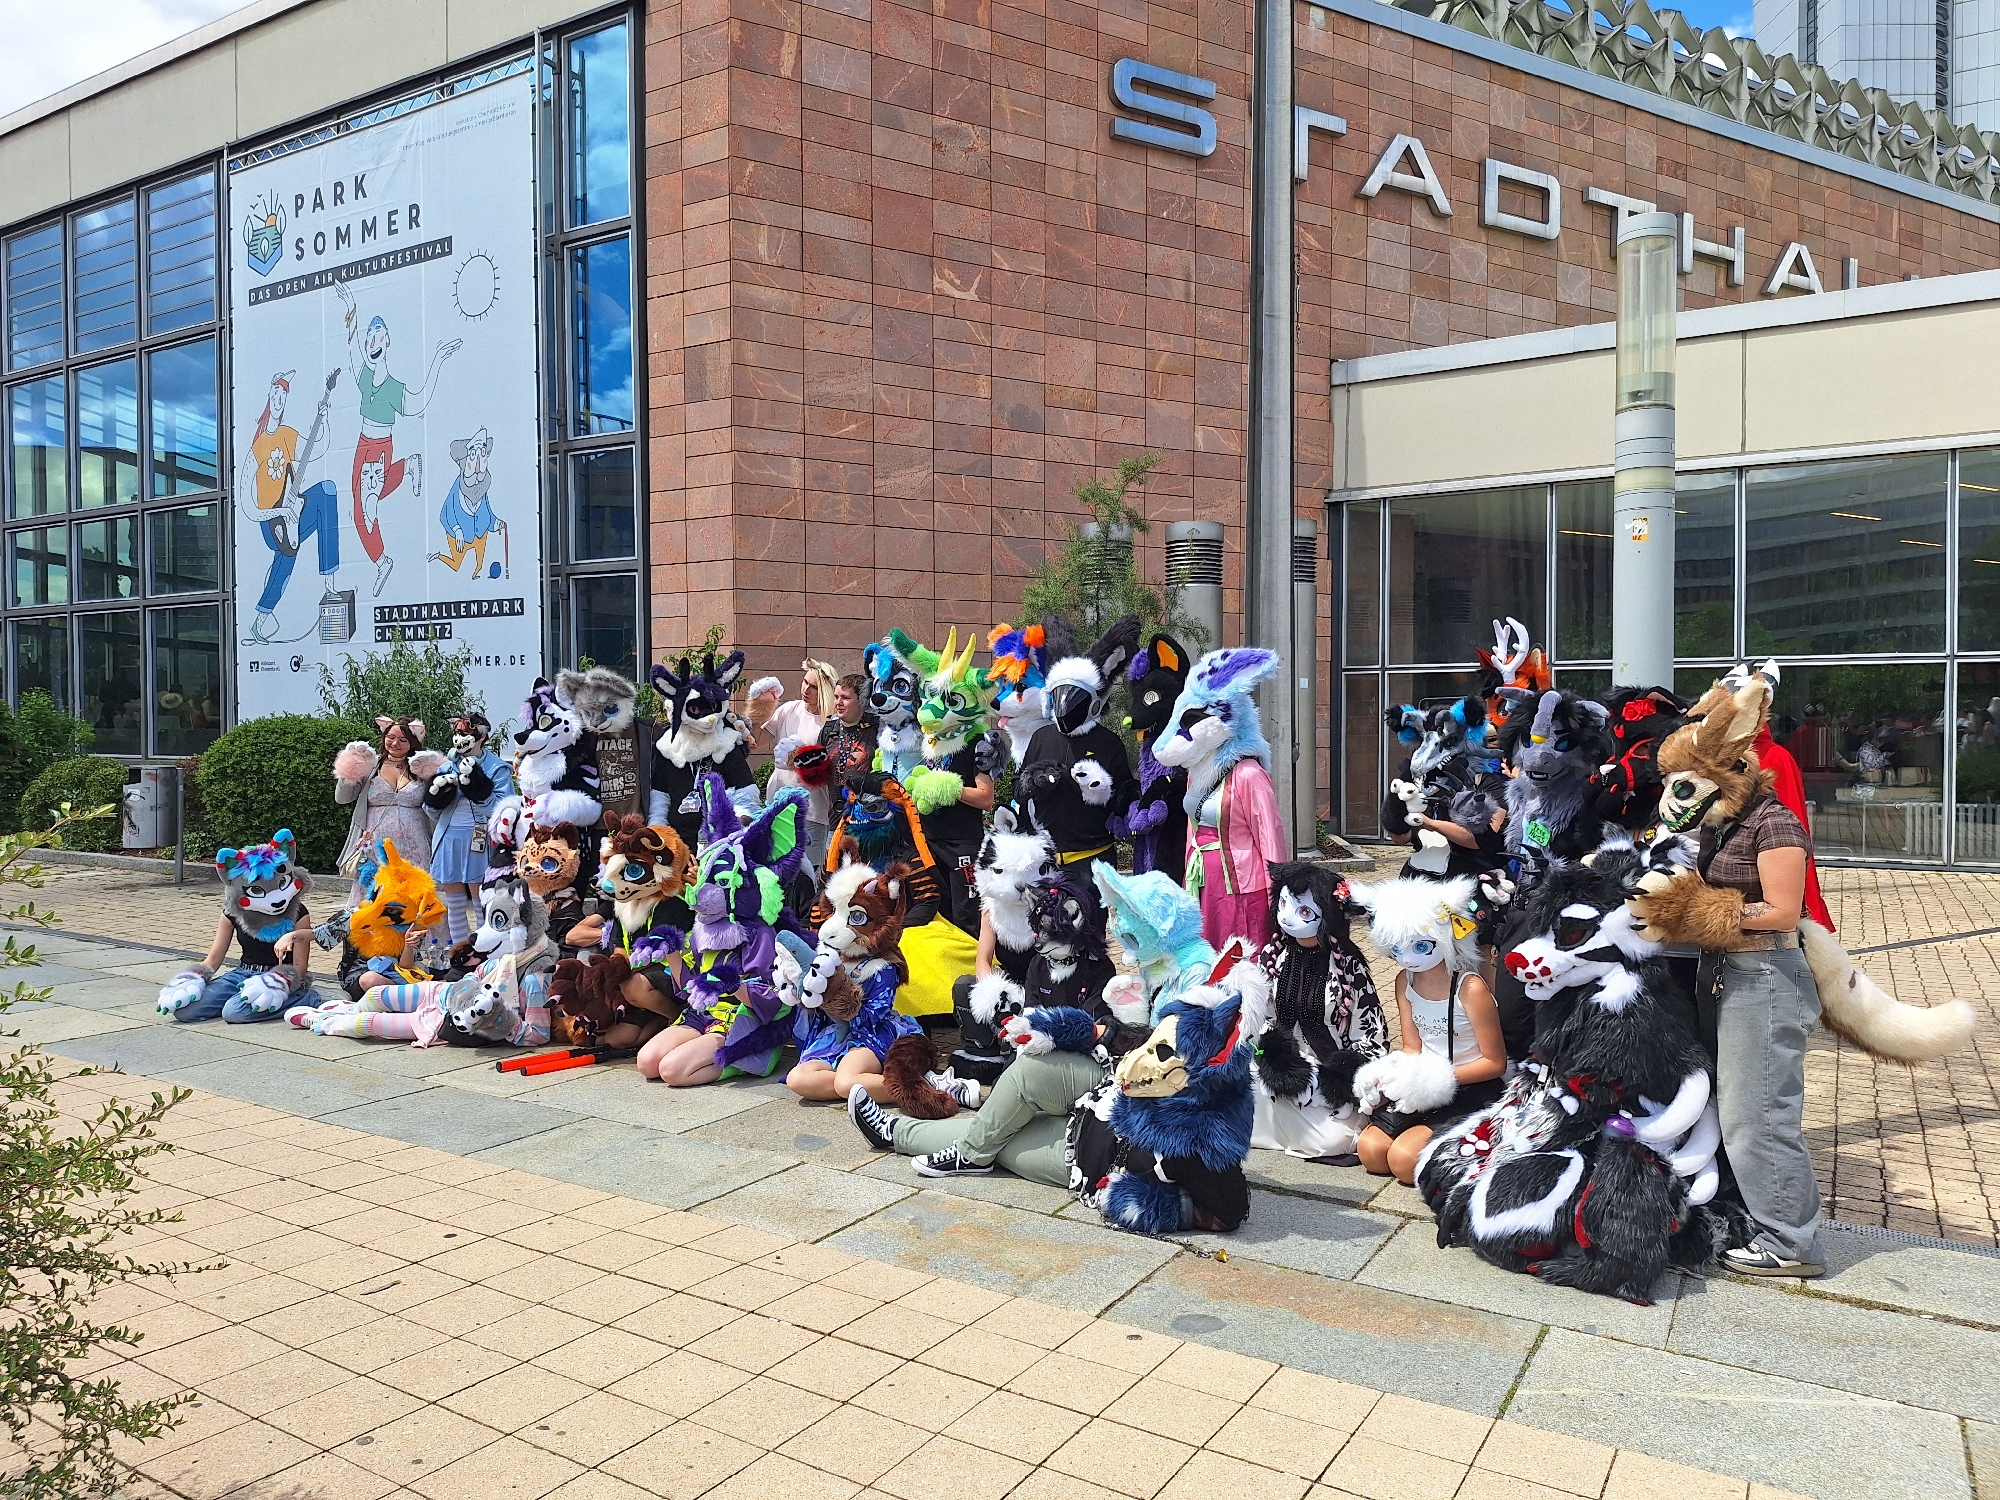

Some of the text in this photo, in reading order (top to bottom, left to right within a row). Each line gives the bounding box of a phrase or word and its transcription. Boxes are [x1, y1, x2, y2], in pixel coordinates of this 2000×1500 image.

[294, 173, 368, 219] PARK
[1109, 58, 1919, 294] STADTHA
[294, 203, 421, 262] SOMMER
[250, 240, 450, 303] DAS OPEN AIR KULTURFESTIVAL
[375, 600, 522, 621] STADTHALLENPARK
[596, 738, 632, 751] NTAGE
[601, 777, 624, 792] IDERS
